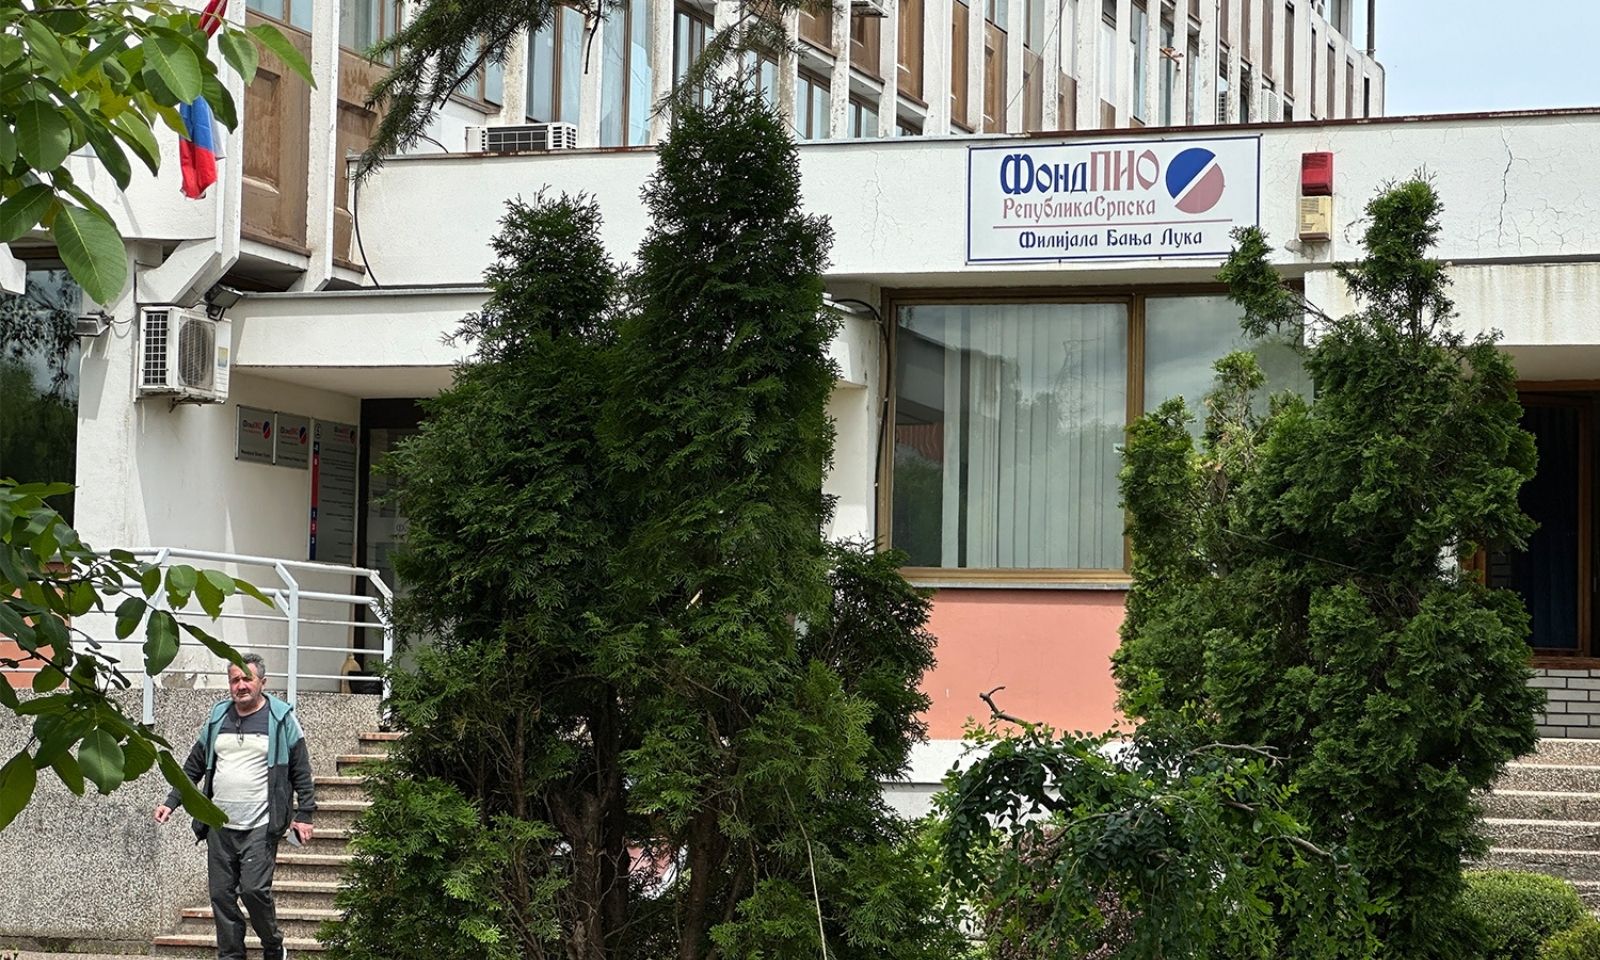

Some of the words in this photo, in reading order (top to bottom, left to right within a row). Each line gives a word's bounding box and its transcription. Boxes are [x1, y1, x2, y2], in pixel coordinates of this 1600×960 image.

[1000, 149, 1160, 195] ФондПИО
[1002, 195, 1156, 223] РепубликаСрпска
[1018, 230, 1098, 250] Филијала
[1106, 228, 1152, 247] Бања
[1160, 228, 1202, 248] Лука
